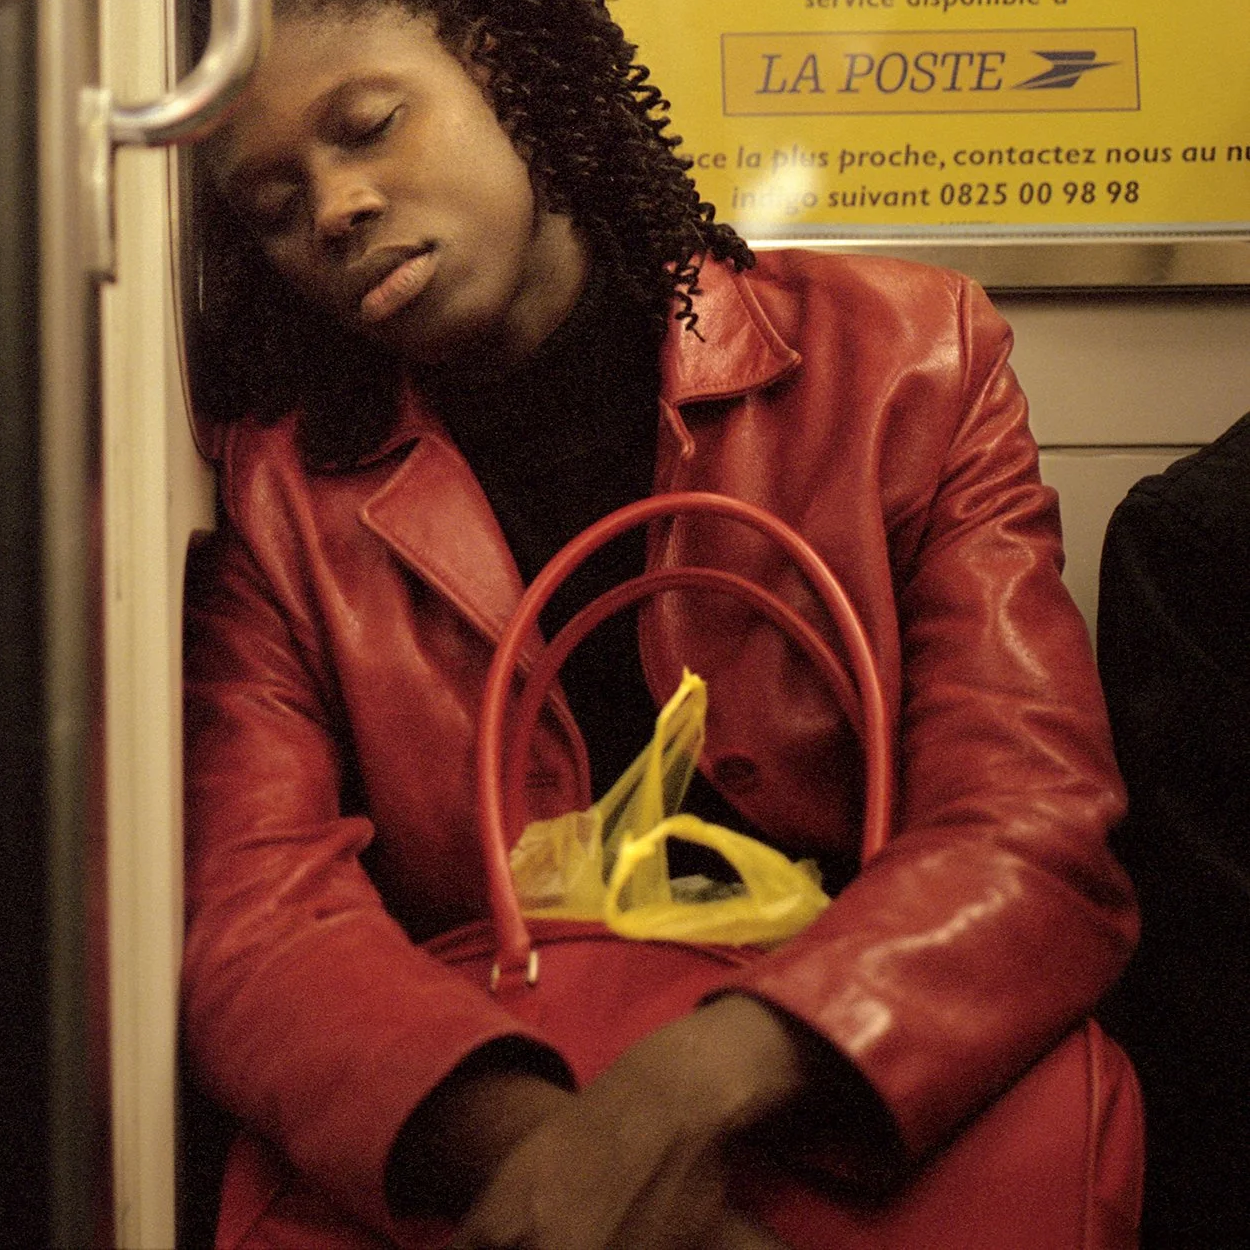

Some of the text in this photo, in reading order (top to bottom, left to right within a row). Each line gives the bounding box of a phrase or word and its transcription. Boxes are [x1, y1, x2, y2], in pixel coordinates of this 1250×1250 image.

[755, 51, 1007, 95] LA POSTE
[736, 146, 762, 168] la
[771, 144, 830, 173] plus
[839, 143, 946, 173] proche,
[953, 146, 1097, 166] contactez
[1106, 145, 1172, 164] nous
[1182, 145, 1216, 163] au
[828, 186, 931, 207] suivant
[940, 182, 1008, 206] 0825
[1018, 181, 1053, 205] 00
[1062, 181, 1097, 204] 98
[1106, 180, 1140, 204] 98
